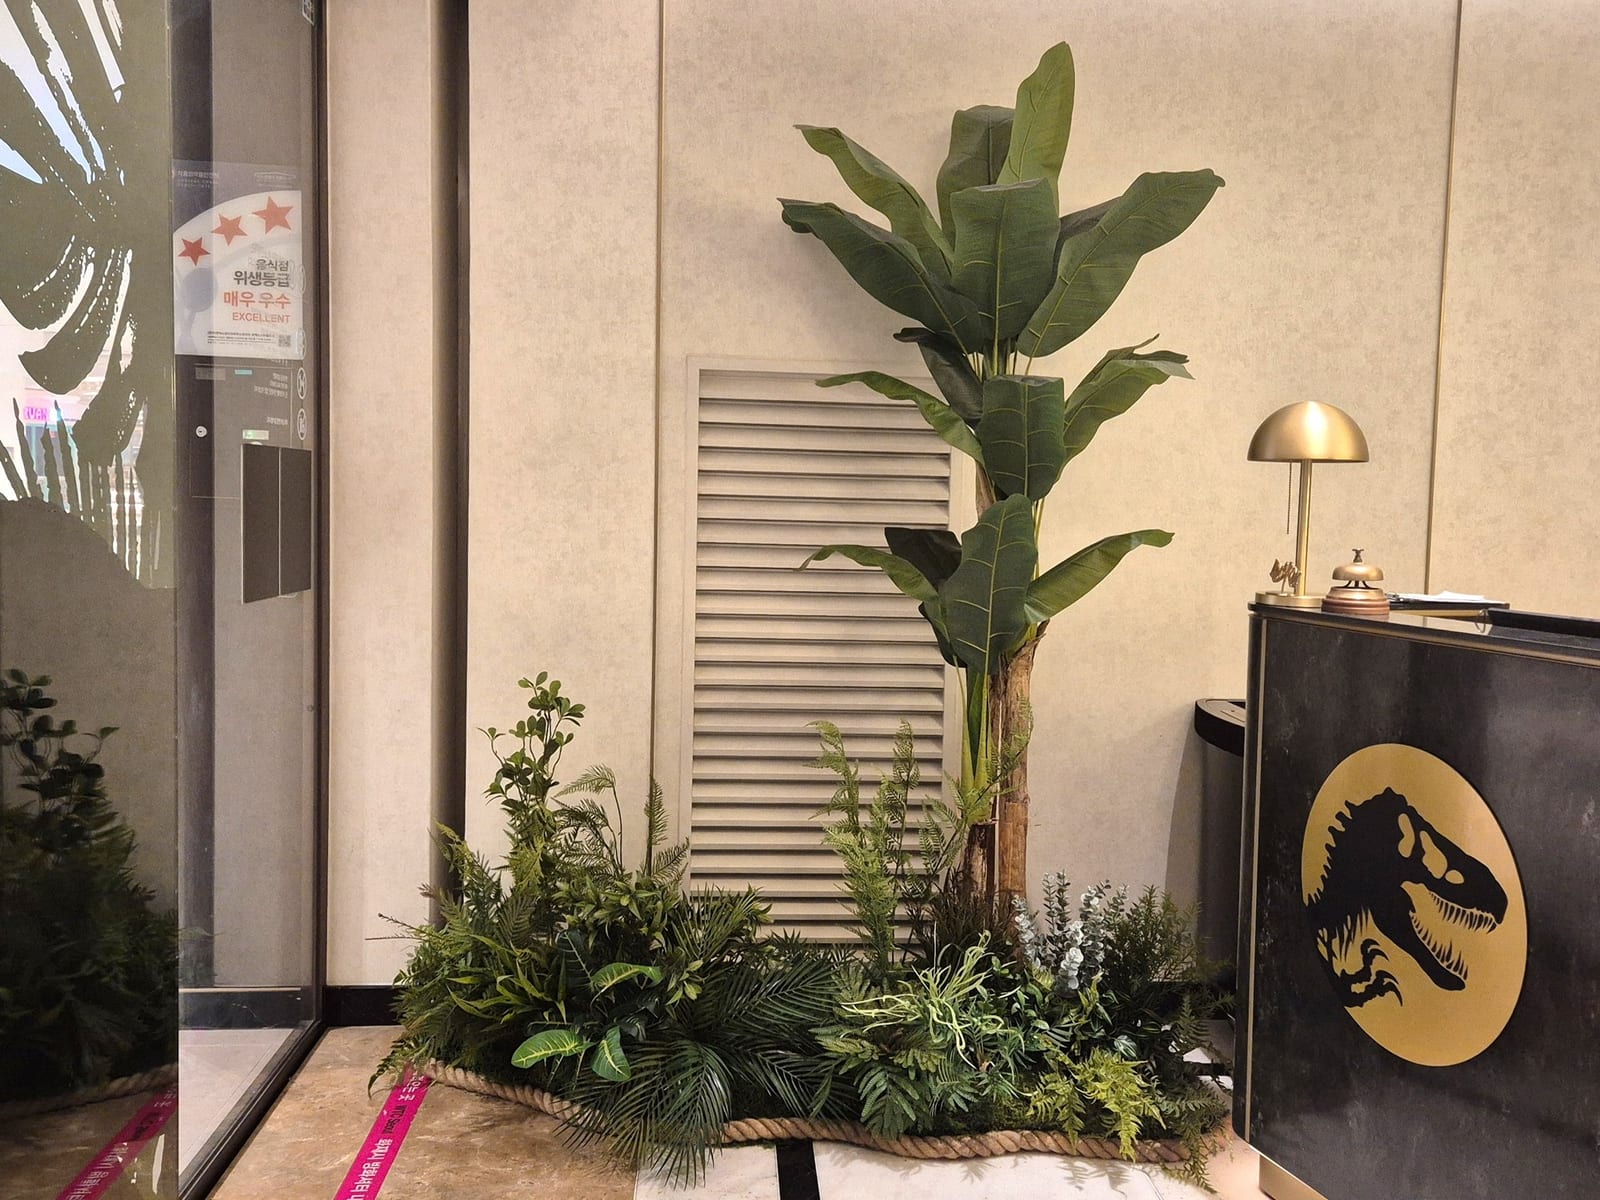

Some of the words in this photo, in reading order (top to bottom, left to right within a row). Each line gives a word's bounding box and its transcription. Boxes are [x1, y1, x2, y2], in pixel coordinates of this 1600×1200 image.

[256, 259, 289, 271] 음식점
[234, 271, 291, 288] 위생등급
[224, 291, 255, 308] 매우
[258, 292, 291, 309] 우수
[232, 312, 291, 323] EXCELLENT
[391, 1105, 407, 1118] WTC
[382, 1118, 401, 1134] Seoul
[367, 1139, 393, 1159] 화재시
[350, 1161, 381, 1192] 방화셔터
